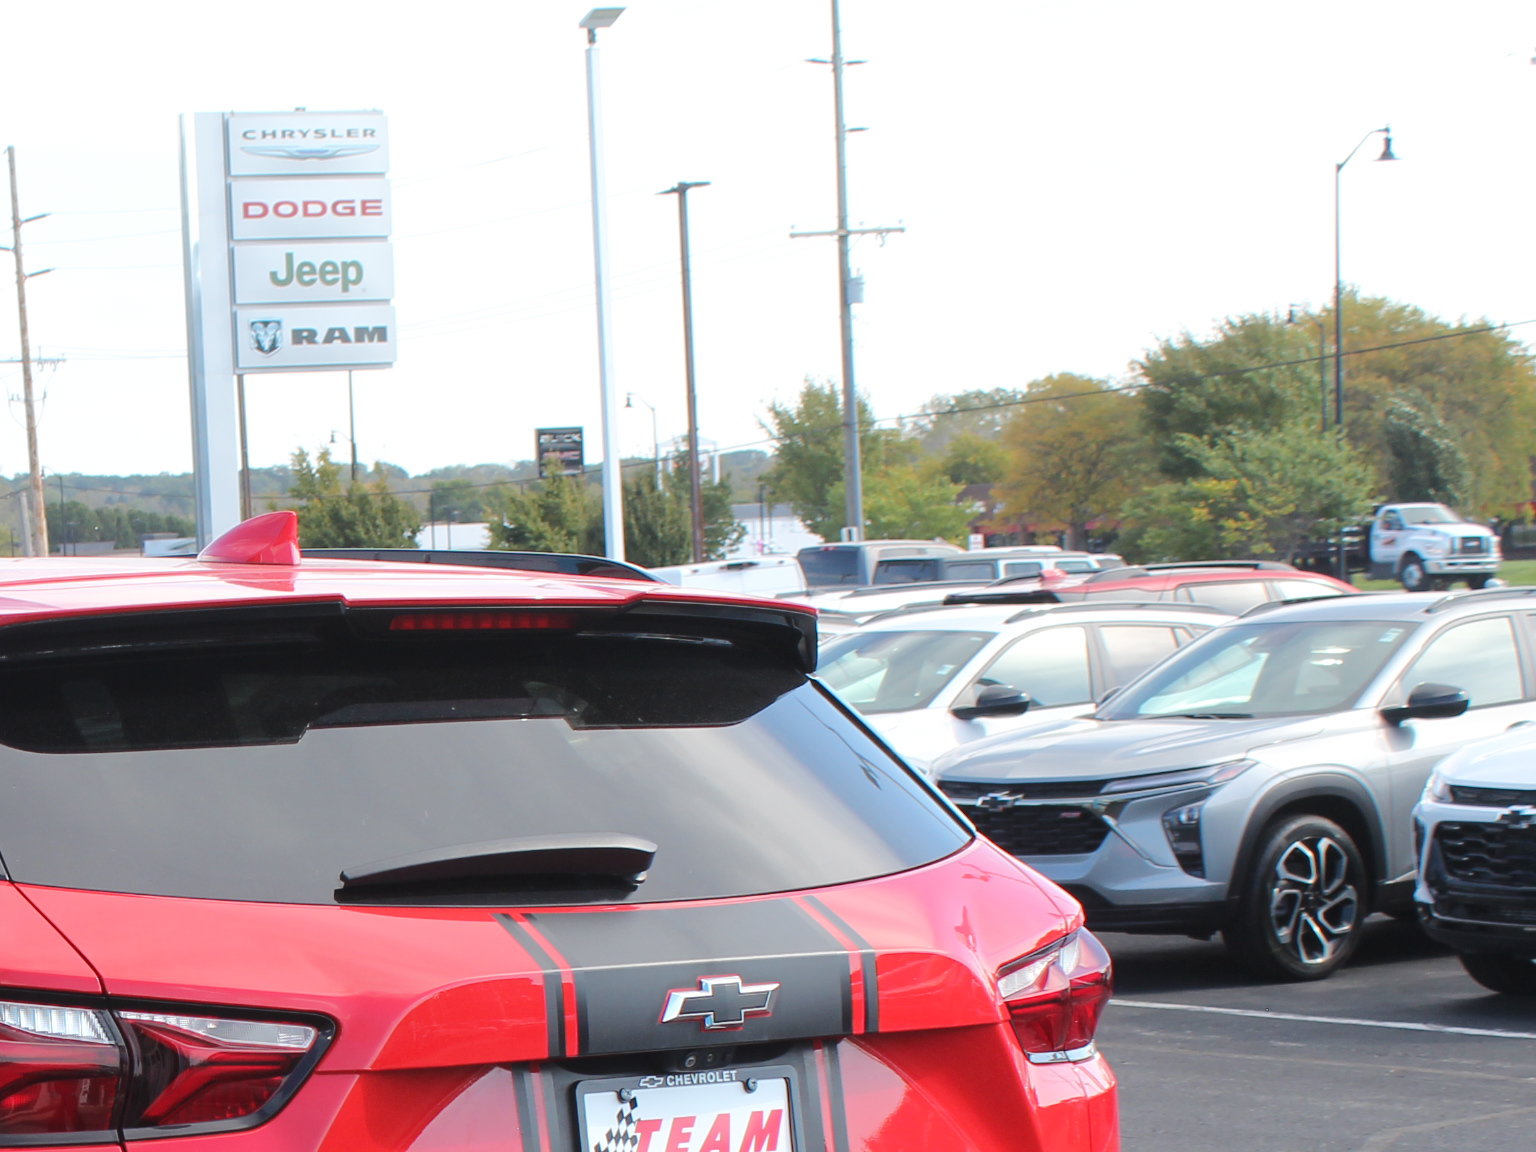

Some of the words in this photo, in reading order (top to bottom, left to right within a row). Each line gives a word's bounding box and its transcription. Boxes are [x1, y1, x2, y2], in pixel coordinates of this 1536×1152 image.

[242, 128, 376, 140] CHRYSLER
[242, 199, 383, 220] DODGE
[269, 252, 364, 293] Jeep
[291, 326, 388, 346] RAM
[666, 1070, 737, 1087] CHEVROLET
